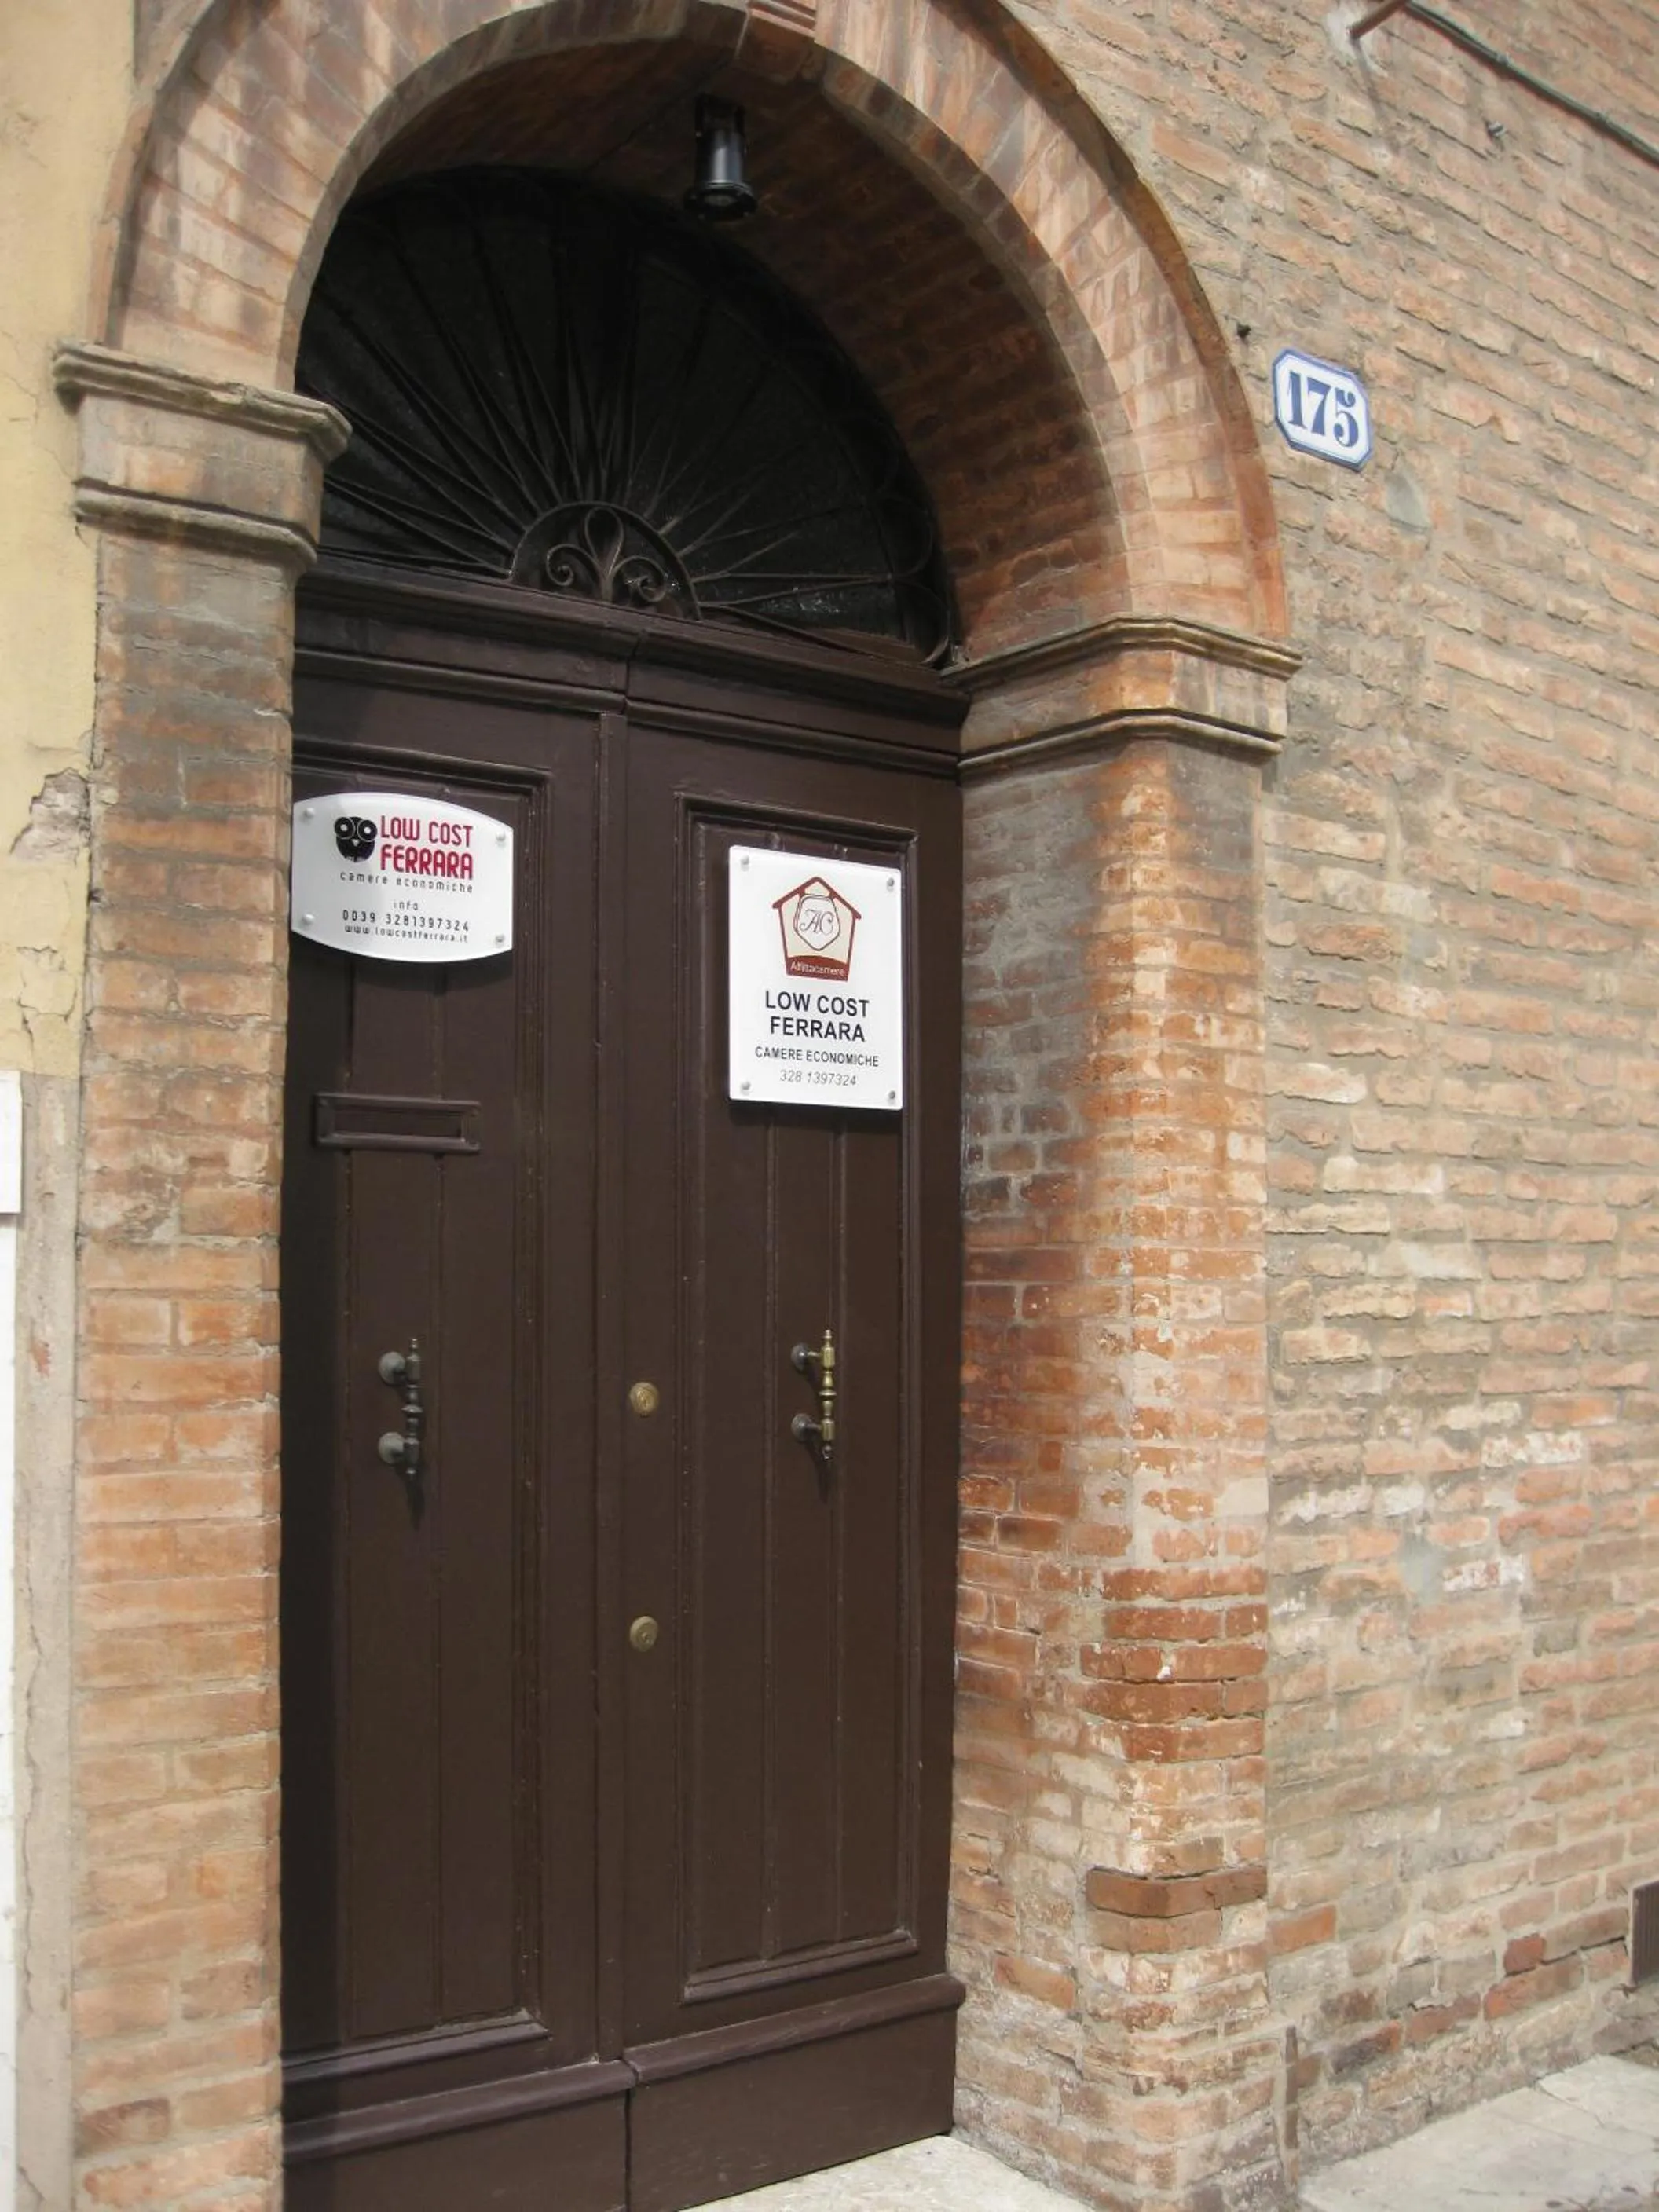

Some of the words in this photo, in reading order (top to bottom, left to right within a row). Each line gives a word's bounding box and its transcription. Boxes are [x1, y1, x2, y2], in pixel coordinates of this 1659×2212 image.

[1287, 370, 1359, 448] 175
[380, 815, 421, 842] LOW
[428, 821, 473, 848] COST
[380, 844, 473, 881] FERRARA
[339, 871, 388, 884] camere
[396, 877, 473, 893] economiche
[394, 900, 419, 910] info
[342, 910, 376, 922] 0039
[386, 914, 469, 932] 3281397324
[344, 925, 468, 943] www.lowcostferrara.it
[765, 990, 810, 1013] LOW
[817, 995, 870, 1017] COST
[770, 1016, 866, 1042] FERRARA
[755, 1046, 803, 1061] CAMERE
[806, 1049, 879, 1067] ECONOMICHE
[779, 1069, 802, 1082] 328
[807, 1071, 856, 1087] 1397324
